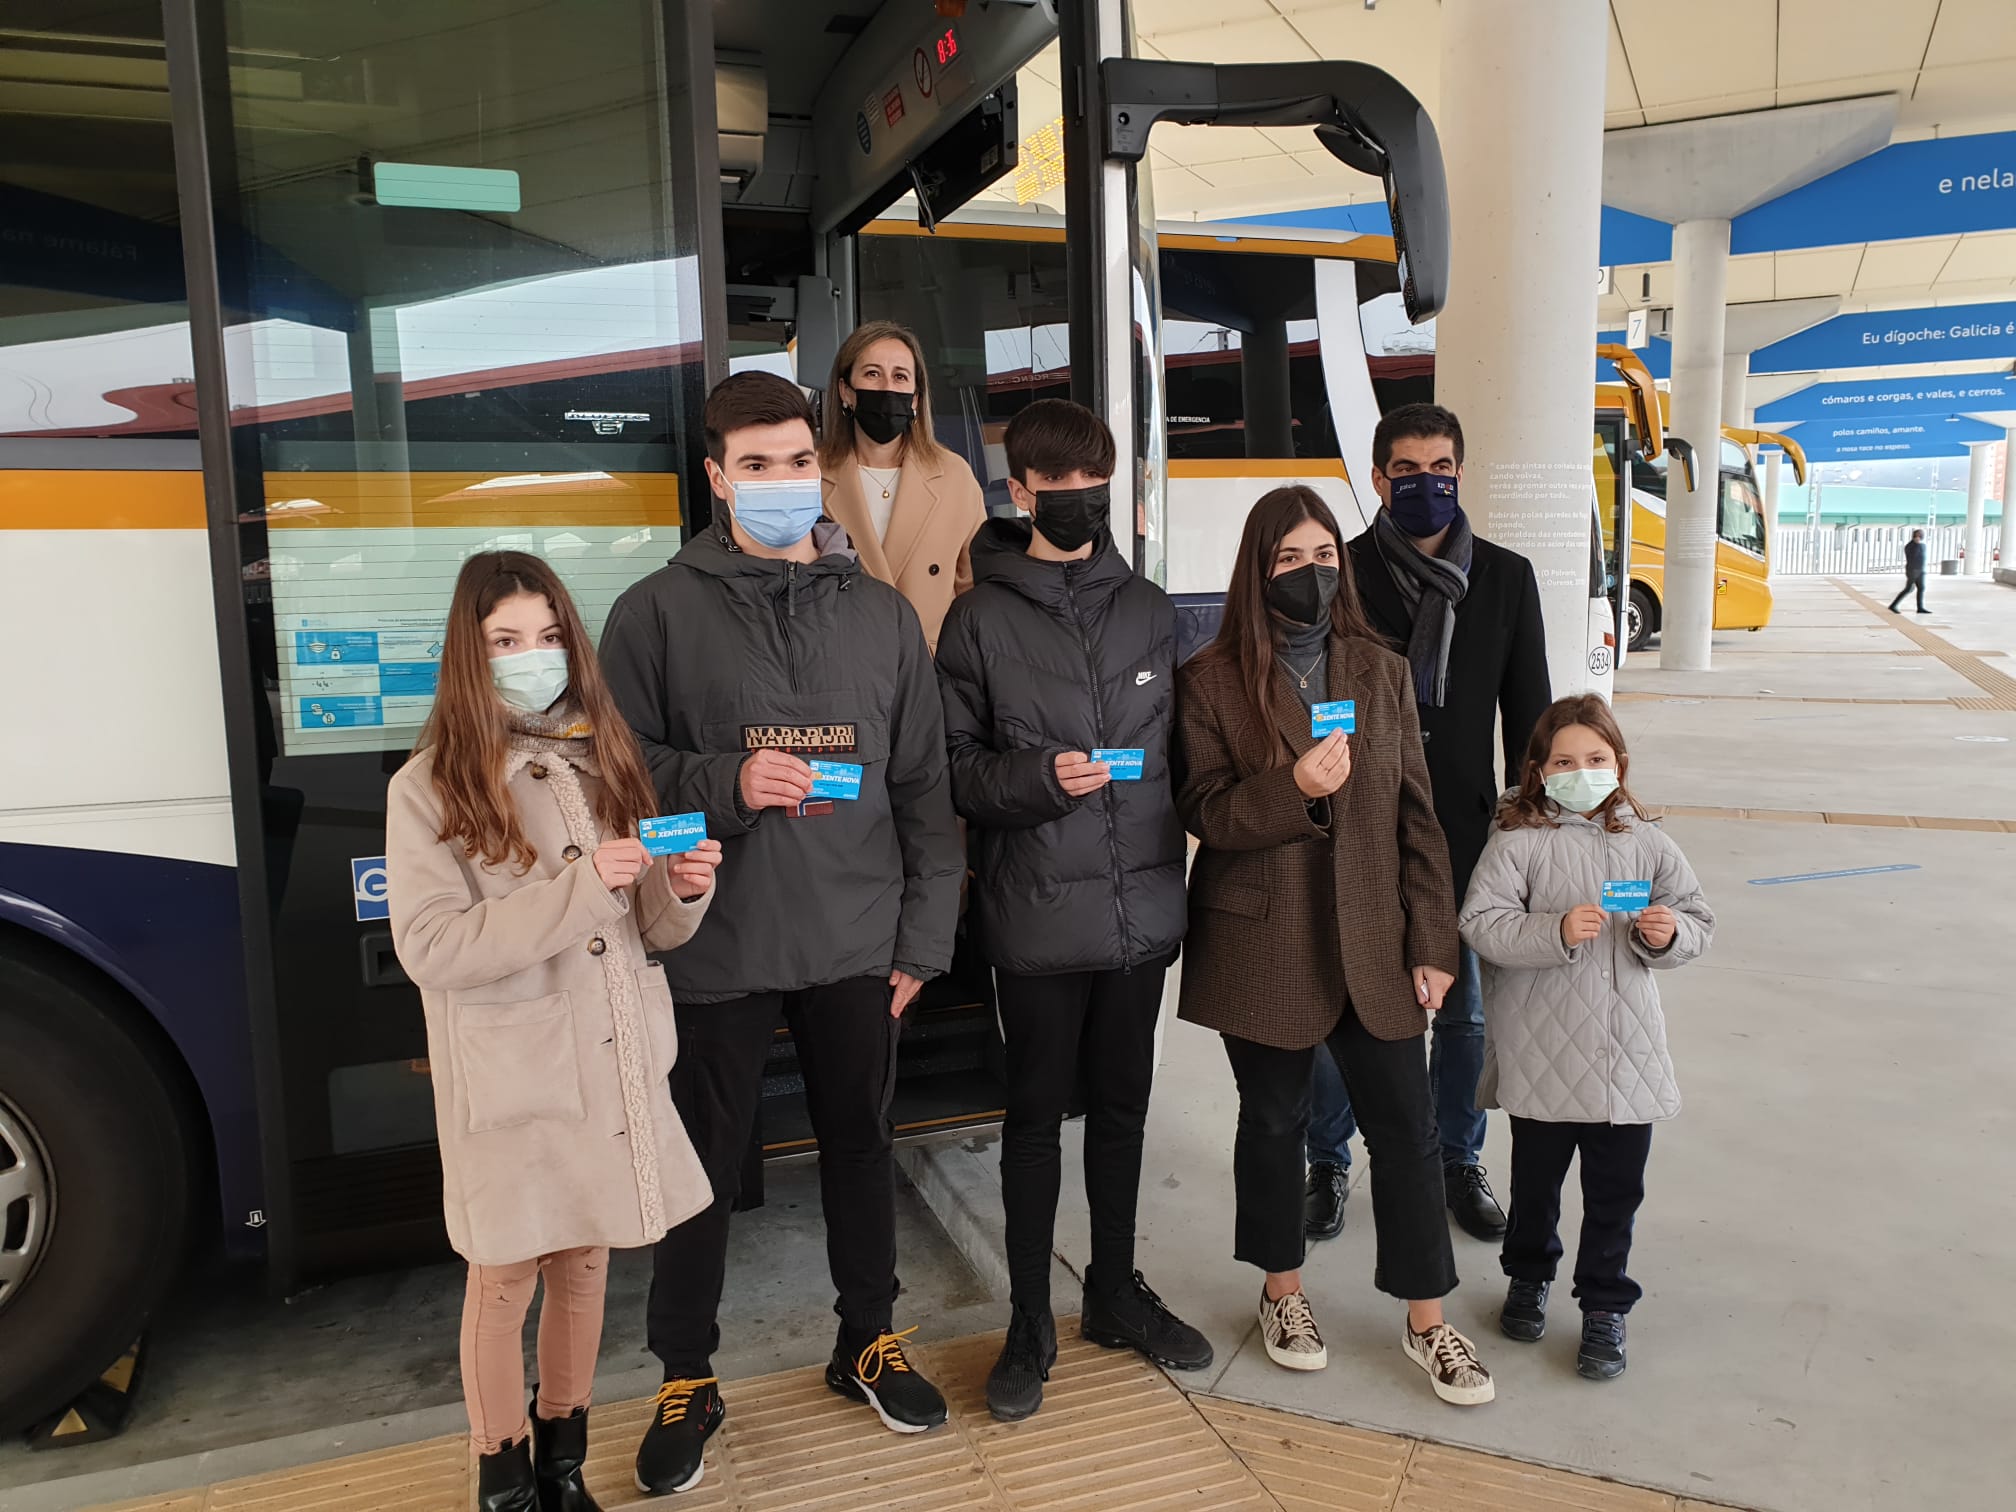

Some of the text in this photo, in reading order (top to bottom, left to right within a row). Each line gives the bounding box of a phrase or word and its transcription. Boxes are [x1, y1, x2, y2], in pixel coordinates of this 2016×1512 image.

[1938, 167, 2015, 194] e nela
[1632, 319, 1642, 340] 7
[1862, 321, 2015, 345] Eu dígoche: Galicia é
[1822, 387, 2006, 405] cómaros e corgas, e vales, e cerros.
[1591, 652, 1609, 670] 2534
[747, 726, 854, 746] NAPAPIJRI
[657, 826, 704, 838] XENTE NOVA
